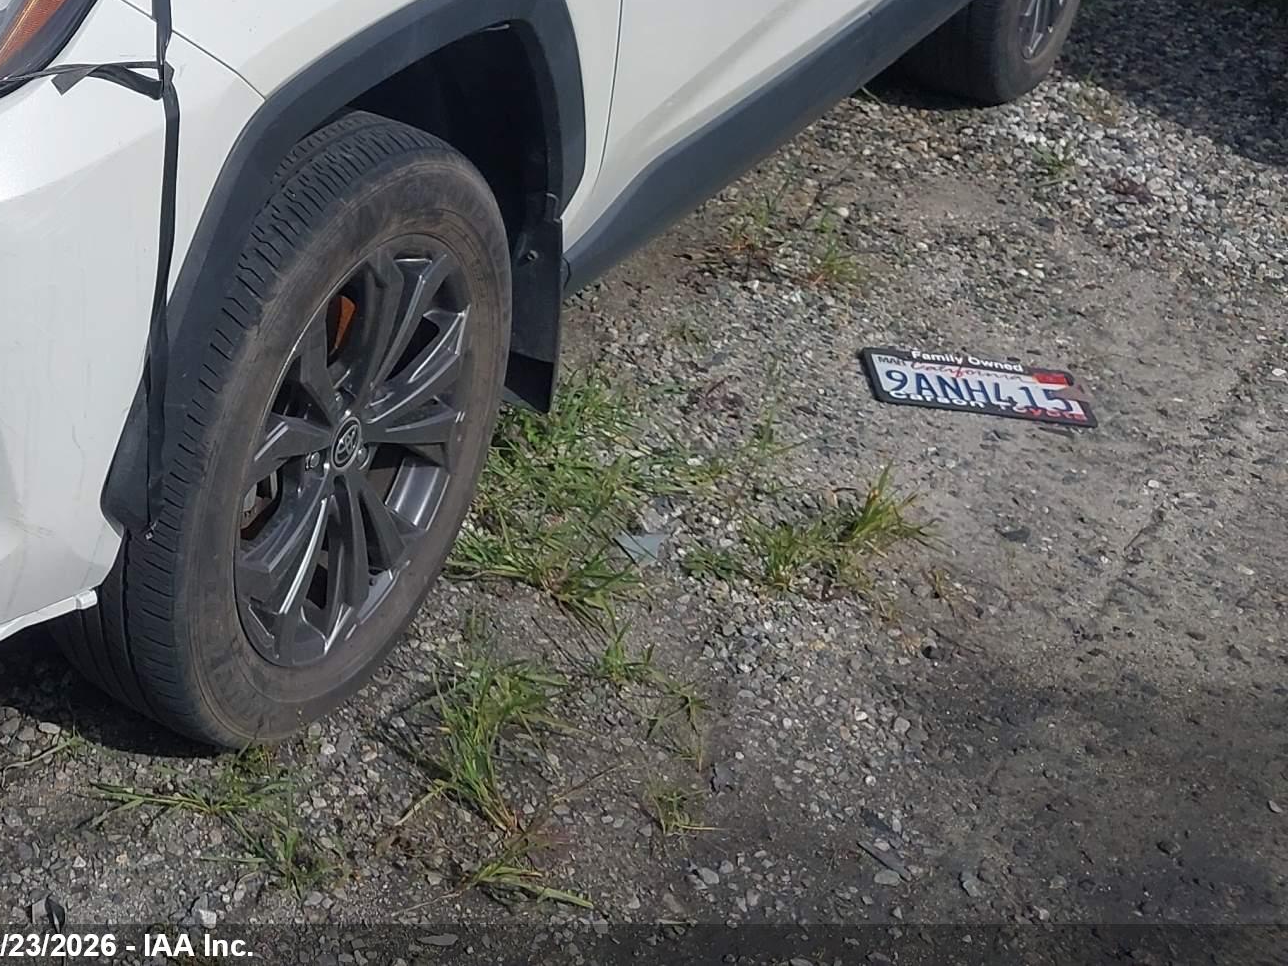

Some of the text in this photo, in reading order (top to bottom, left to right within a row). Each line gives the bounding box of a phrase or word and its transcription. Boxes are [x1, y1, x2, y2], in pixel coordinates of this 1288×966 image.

[911, 350, 1024, 373] Family Owned
[886, 369, 1066, 411] 9ANH415
[889, 390, 985, 408] Carson
